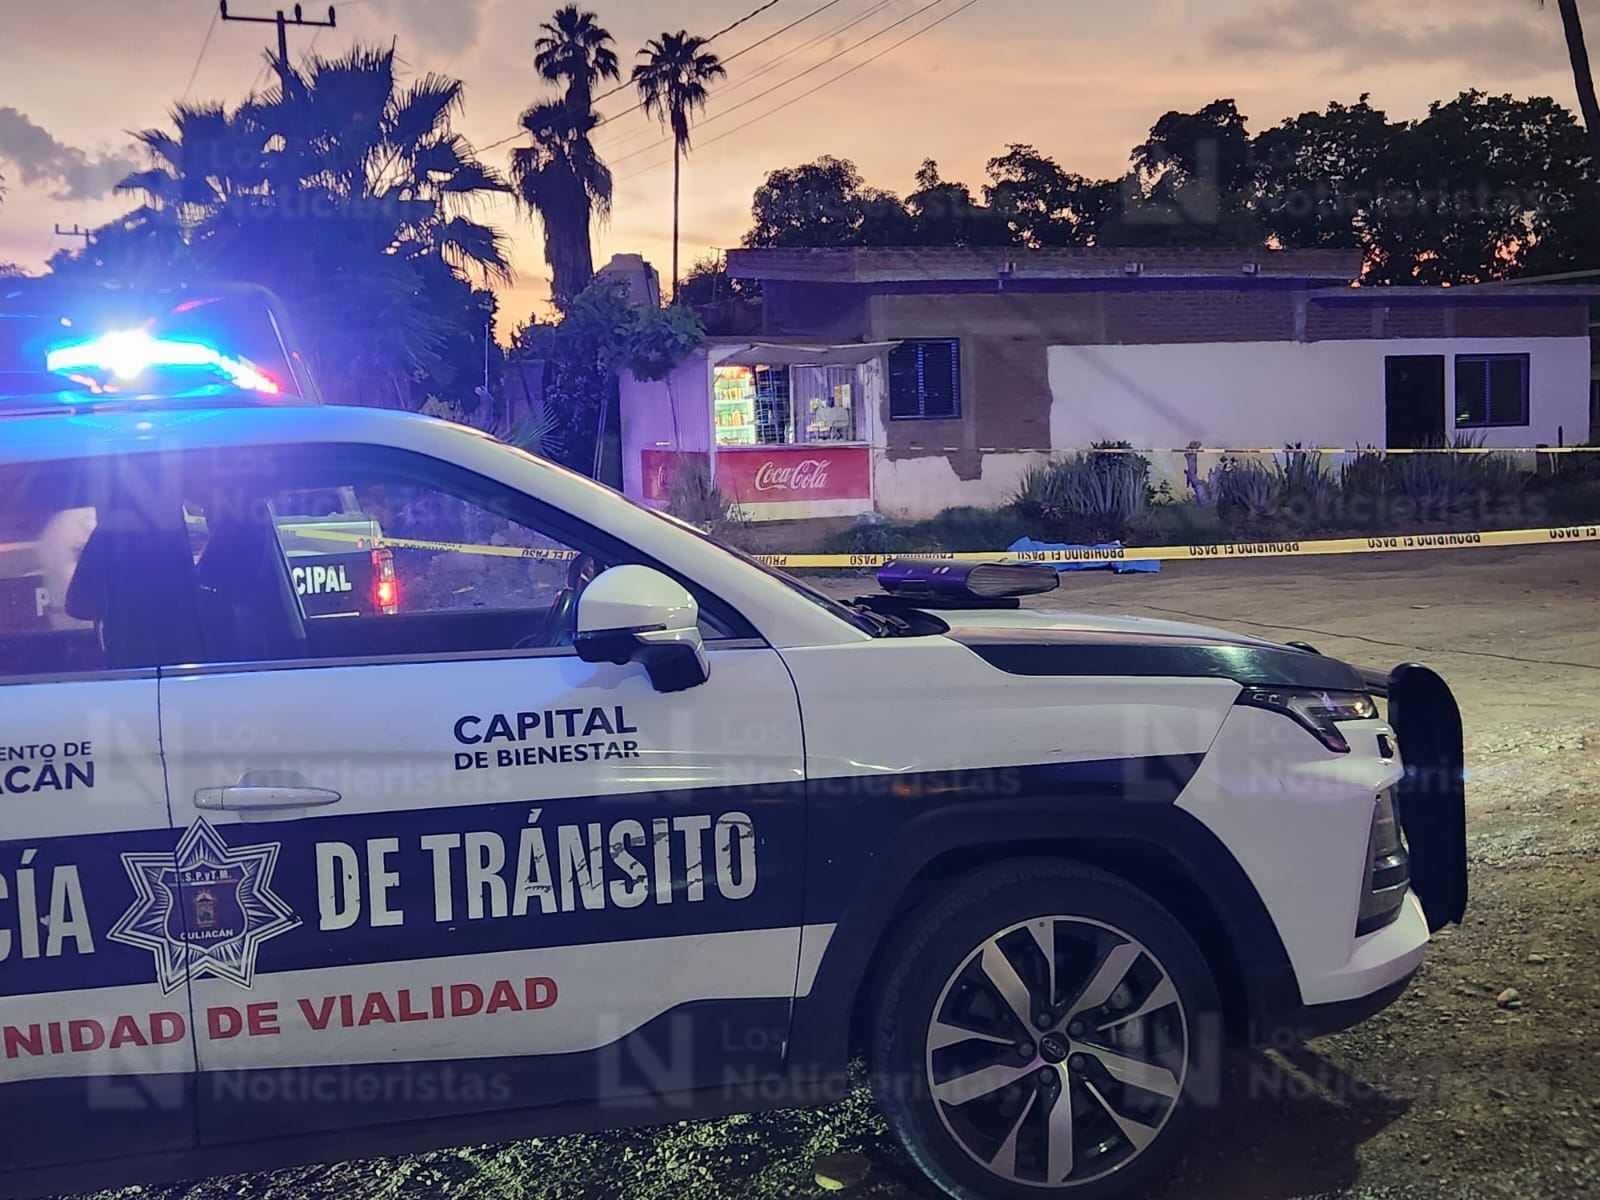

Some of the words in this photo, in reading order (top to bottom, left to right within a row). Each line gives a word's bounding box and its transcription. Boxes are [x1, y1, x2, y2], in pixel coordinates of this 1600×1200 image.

[453, 706, 637, 745] CAPITAL
[64, 741, 92, 757] DE
[454, 752, 489, 770] DE
[497, 740, 640, 767] BIENESTAR
[0, 759, 94, 794] CÁN
[0, 848, 95, 961] ÍA
[315, 837, 404, 931] DE
[421, 808, 757, 923] TRÁNSITO
[3, 1011, 186, 1059] NIDAD
[207, 1001, 281, 1040] DE
[297, 977, 559, 1031] VIALIDAD
